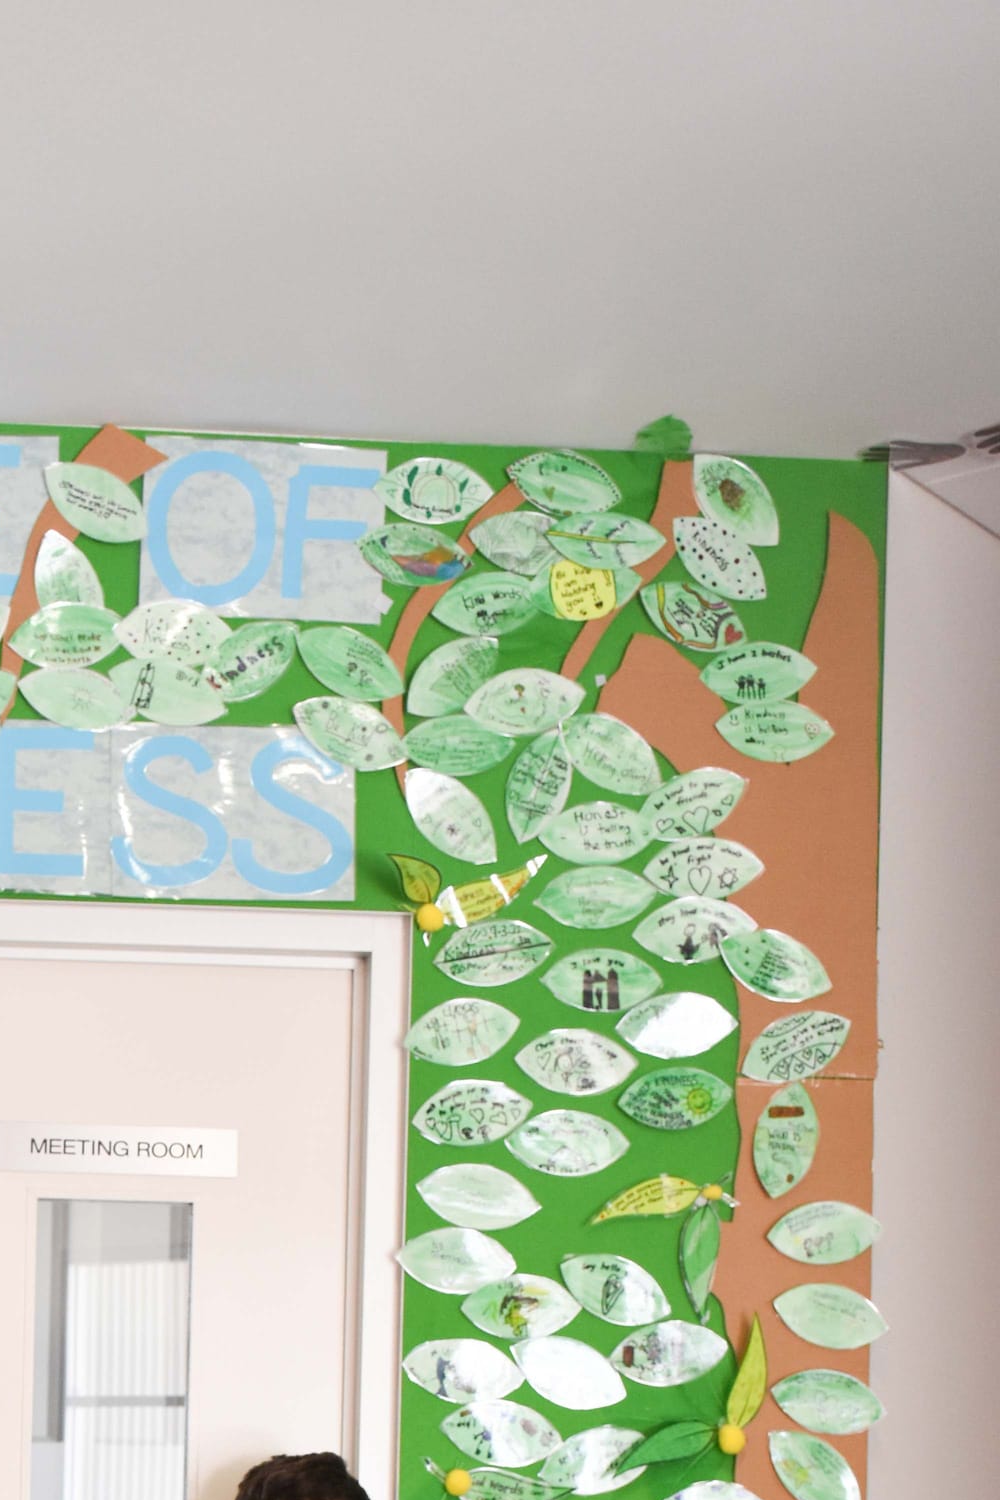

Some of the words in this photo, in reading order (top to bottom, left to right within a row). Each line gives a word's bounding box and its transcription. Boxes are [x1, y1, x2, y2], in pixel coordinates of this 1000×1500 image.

[147, 450, 381, 607] OF
[205, 635, 285, 690] Kindness
[30, 1138, 129, 1157] MEETING
[137, 1141, 204, 1159] ROOM
